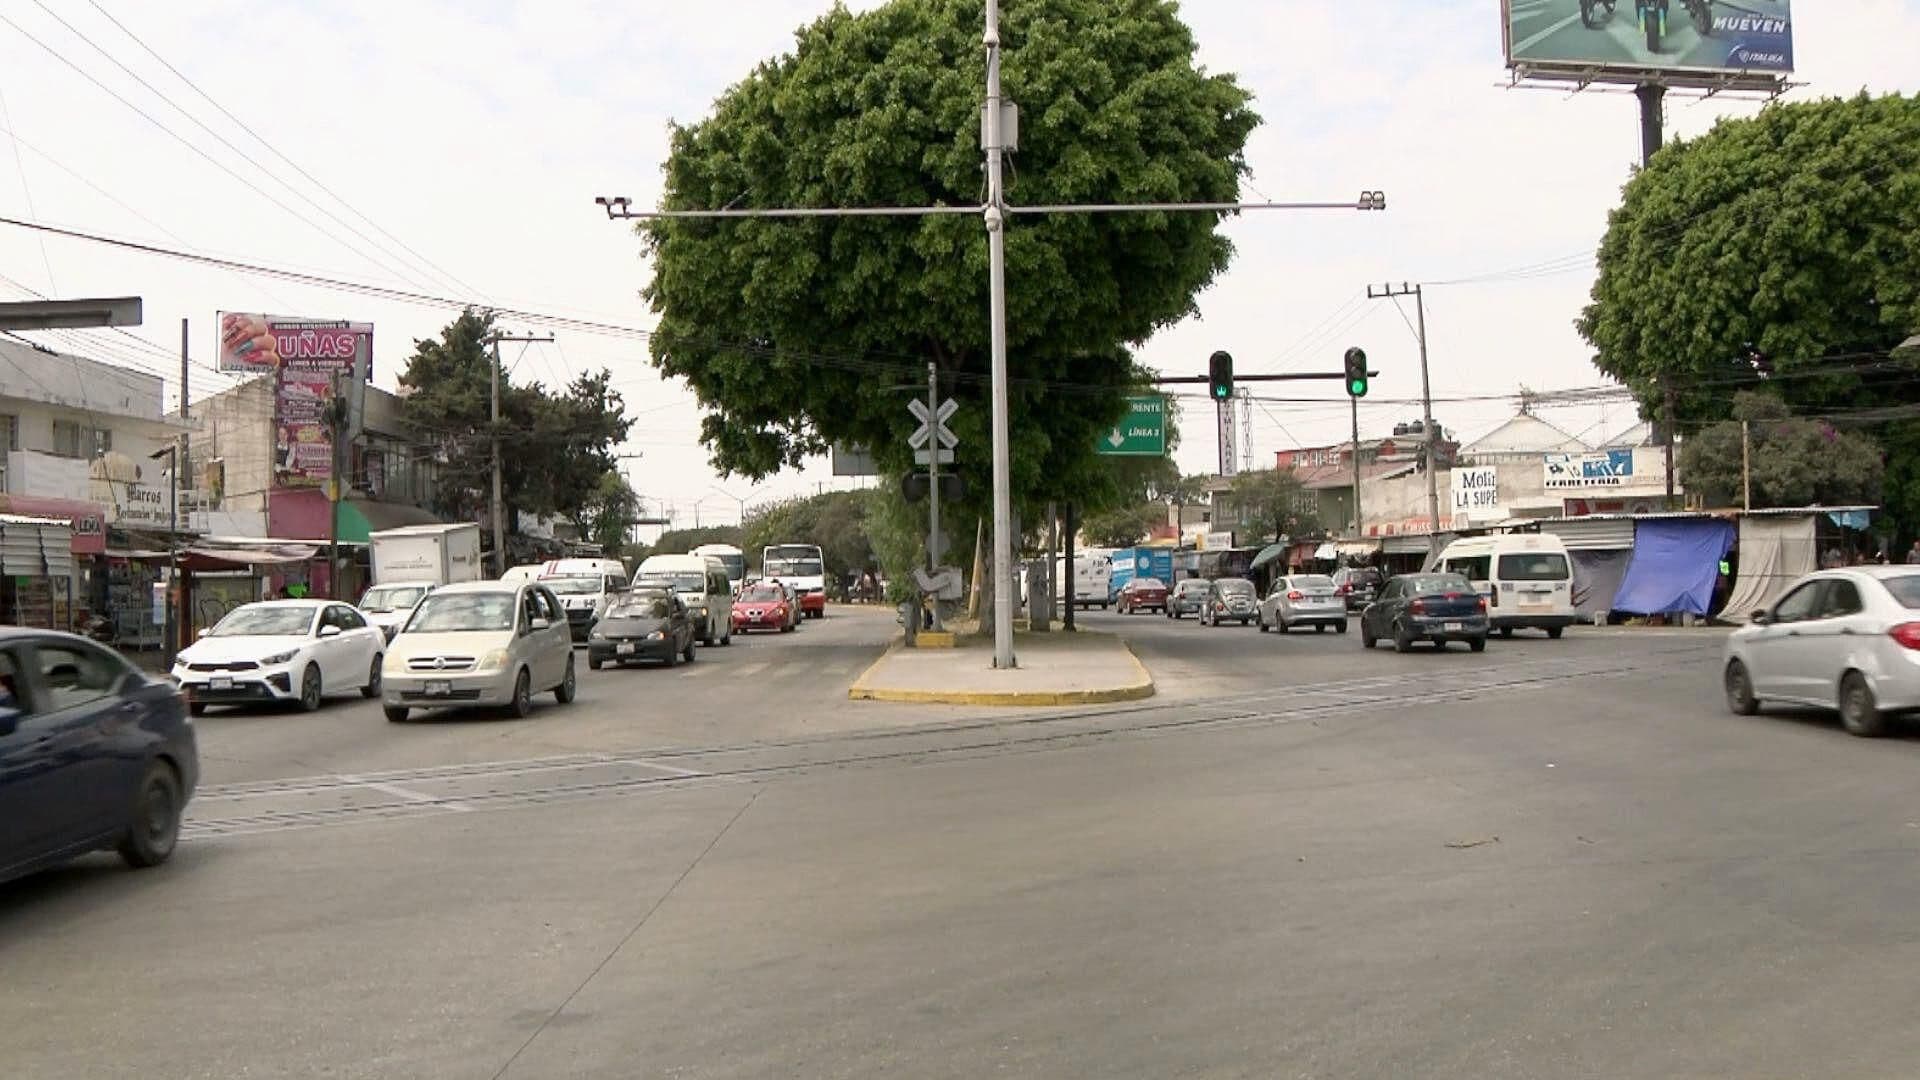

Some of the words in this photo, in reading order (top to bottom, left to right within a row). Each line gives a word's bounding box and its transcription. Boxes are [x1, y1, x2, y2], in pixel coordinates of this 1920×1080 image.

[1713, 16, 1786, 33] MUEVEN
[278, 330, 355, 358] UÑAS
[1128, 426, 1153, 437] LÍNEA
